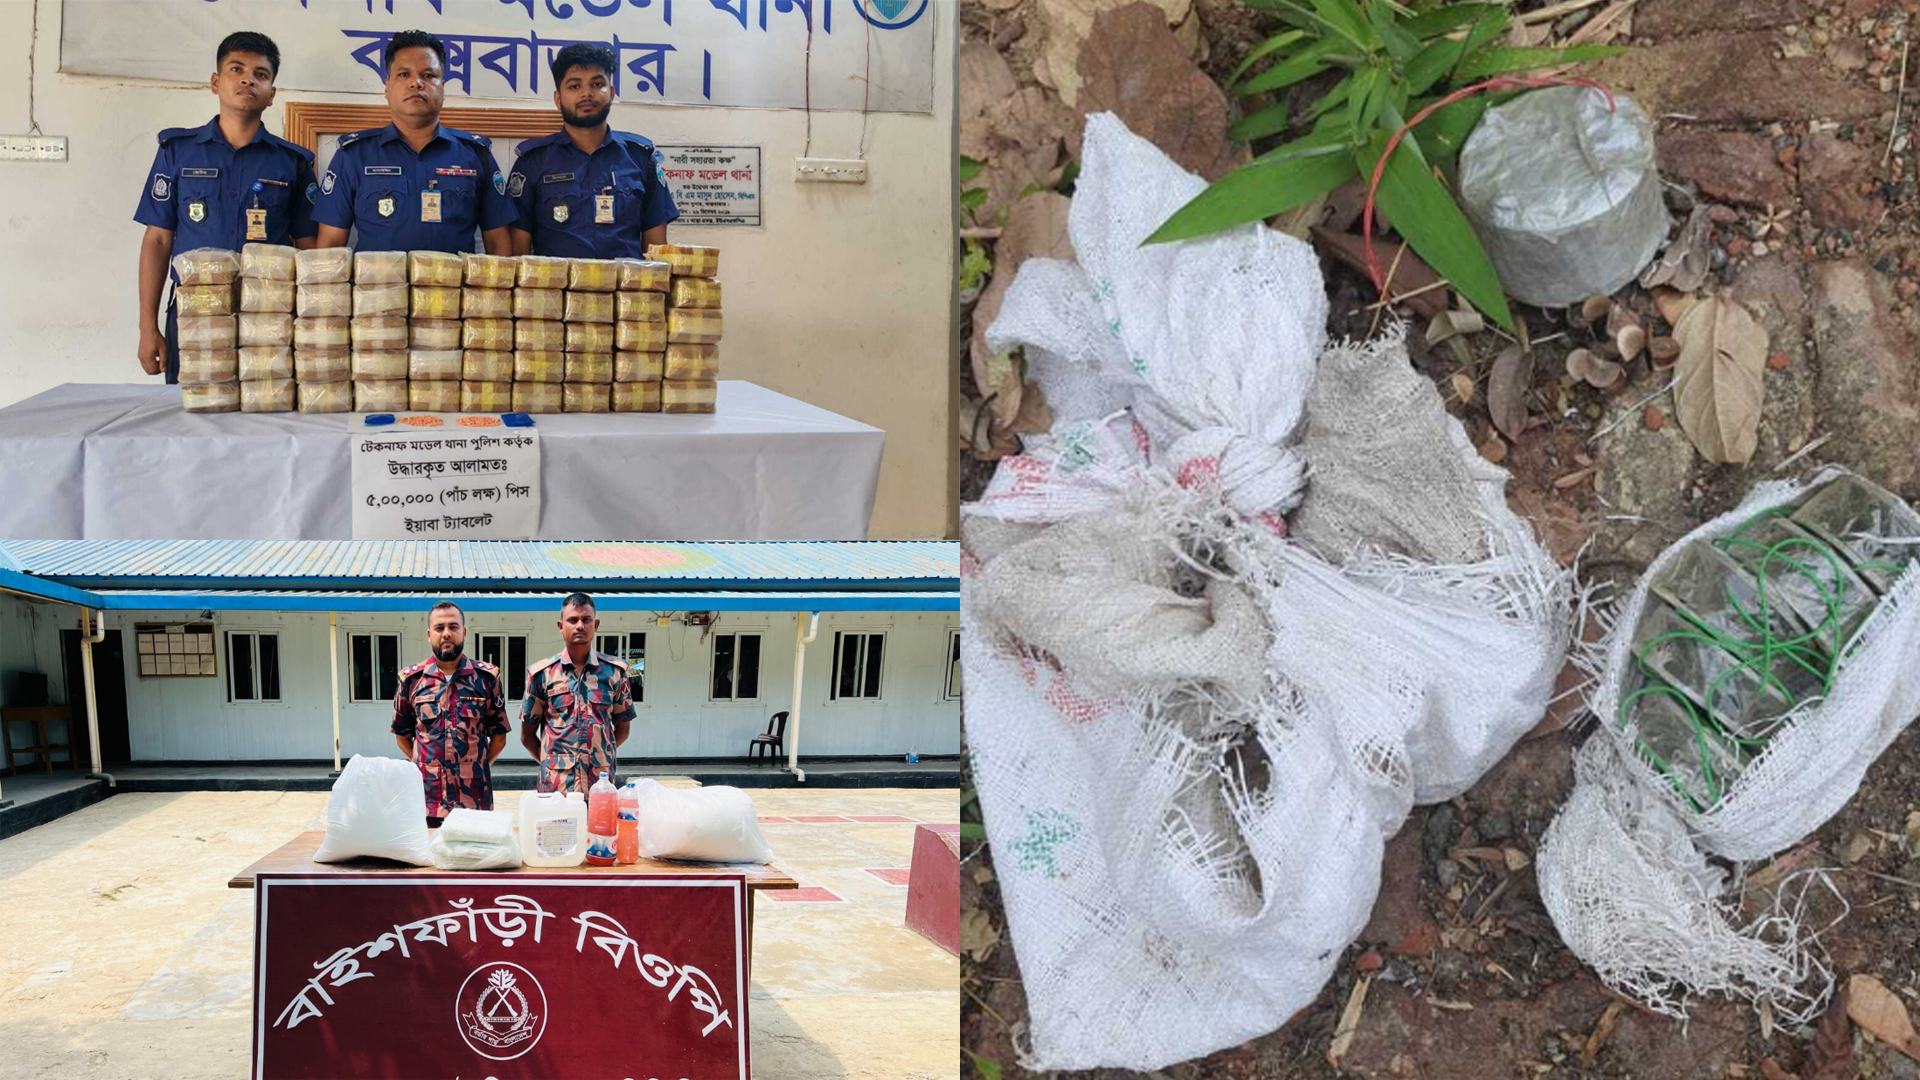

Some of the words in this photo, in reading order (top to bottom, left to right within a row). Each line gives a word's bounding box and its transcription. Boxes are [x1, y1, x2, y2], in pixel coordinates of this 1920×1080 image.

[341, 30, 677, 97] কক্সবাার
[699, 169, 727, 181] মডেল
[731, 168, 753, 181] থানা
[360, 440, 407, 453] টেকনাফ
[410, 440, 442, 452] মডেল
[444, 439, 468, 450] থানা
[470, 435, 501, 452] পুলিশ
[503, 435, 534, 449] কর্তৃক
[388, 459, 446, 480] উদ্ধারকৃত
[450, 458, 508, 474] আলামতঃ
[366, 493, 434, 509] ৫,০০,০০০
[439, 485, 469, 506] (পাঁচ
[472, 486, 502, 504] লক্ষ)
[505, 483, 530, 499] পিস
[404, 517, 440, 534] ইয়াবা
[443, 512, 494, 530] ট্যাবলেট
[273, 894, 556, 1030] বাইশফাঁড়ী
[571, 910, 734, 1037] বিওপি
